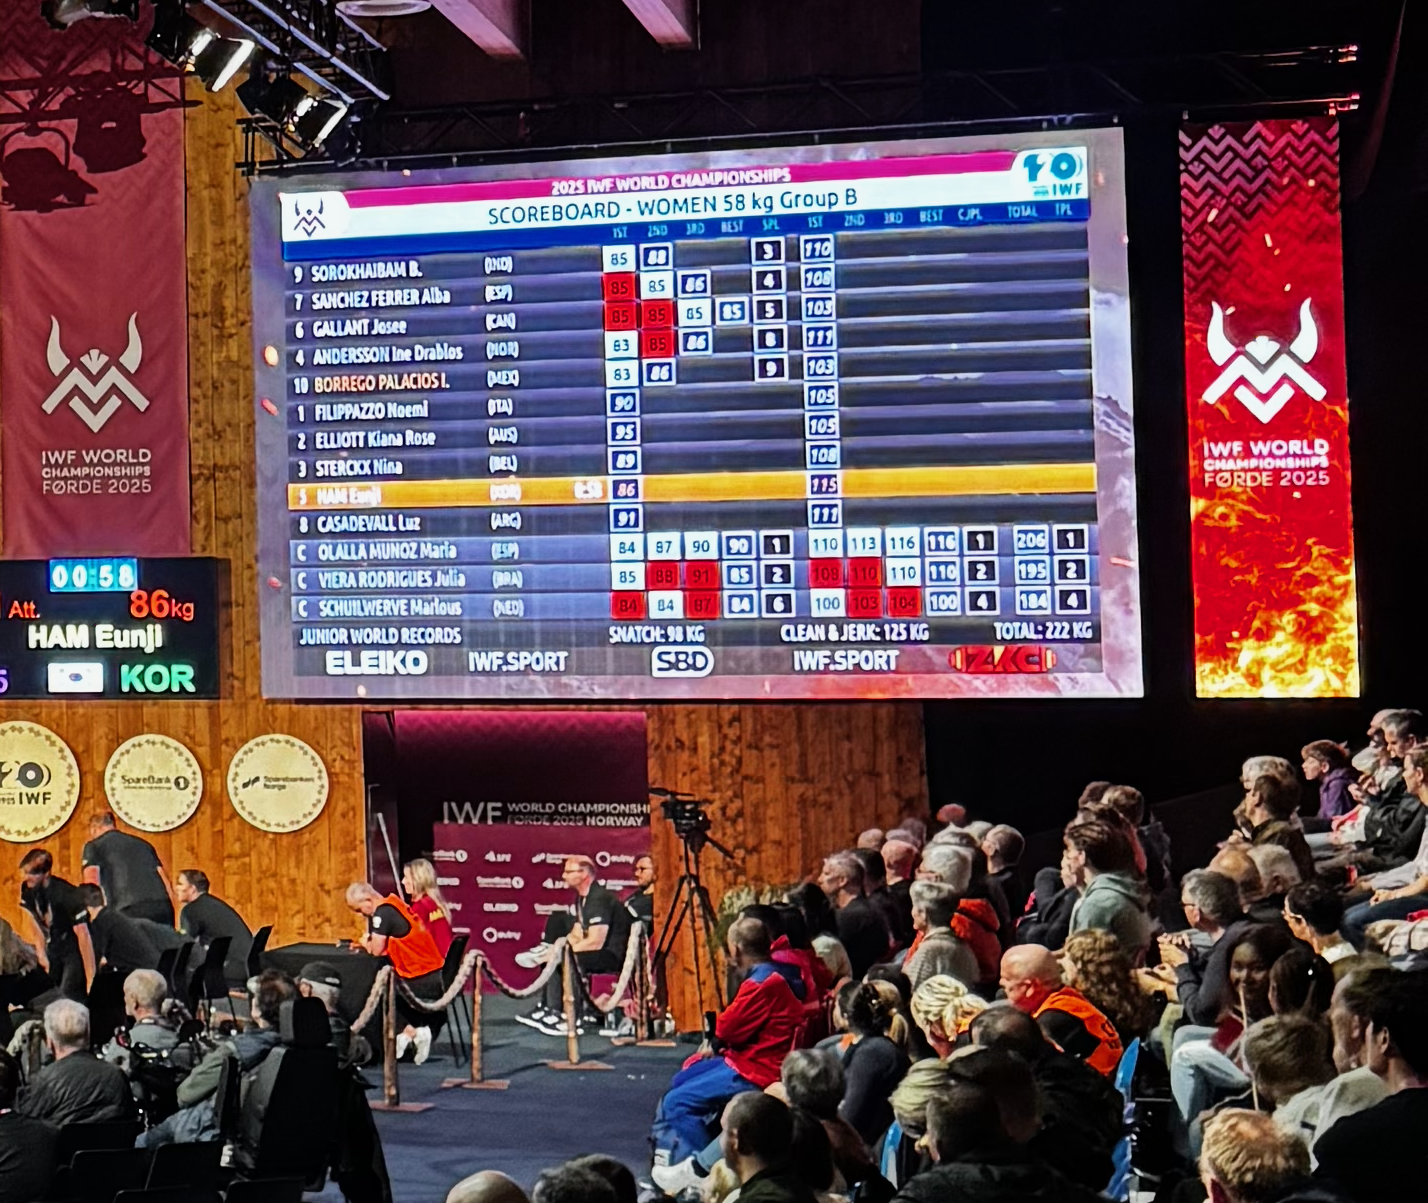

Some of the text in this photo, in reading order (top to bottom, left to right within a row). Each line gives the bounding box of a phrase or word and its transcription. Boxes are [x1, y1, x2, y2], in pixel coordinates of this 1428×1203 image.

[552, 168, 791, 195] 2025 IWF WORLD CHAMPIONSHIPS
[1052, 183, 1083, 196] IWF
[489, 188, 858, 225] SCOREBOARD WOMEN 58 kg Group B
[721, 209, 944, 233] BEST BEST
[294, 241, 832, 283] 9 SOROKHAIBAM 85 110
[311, 290, 370, 310] SANCHEZ
[371, 288, 419, 308] FERRER
[421, 286, 450, 304] Alba
[648, 279, 665, 292] 85
[313, 317, 407, 338] GALLANT Josee
[295, 349, 305, 366] 4
[313, 346, 391, 365] ANDERSSON
[414, 343, 463, 361] Drablos
[294, 372, 439, 394] 10 BORREGO PALACIOS
[315, 402, 385, 421] FILIPPAZZO
[387, 400, 429, 418] Noemi
[315, 431, 366, 450] ELLIOTT
[367, 430, 403, 448] Kiana
[405, 429, 436, 446] Rose
[1204, 438, 1329, 457] IWF WORLD
[42, 449, 151, 464] IWF WORLD
[315, 457, 403, 477] STERCKX Nina
[1203, 456, 1329, 471] CHAMPIONSHIPS
[42, 466, 151, 478] CHAMPIONSHIPS
[1204, 470, 1330, 488] FØRDE 2025
[42, 479, 151, 495] FØRDE 2025
[811, 477, 837, 492] 115
[317, 515, 397, 533] CASADEVALL
[398, 514, 421, 531] Luz
[617, 511, 636, 527] 91
[812, 507, 838, 522] 111
[318, 532, 1045, 561] OLALLA MUNOZ Maria 84 87 90 110 113 116 116 206
[51, 566, 135, 588] 00:58
[319, 563, 1047, 589] VIERA RODRIGUES Julia 85 110 110 195
[8, 601, 40, 619] Att.
[319, 598, 408, 617] SCHUILWERVE
[657, 599, 674, 611] 84
[815, 597, 840, 611] 100
[930, 593, 957, 609] 100
[28, 625, 163, 653] HAM Eunji
[300, 628, 348, 645] JUNIOR
[350, 628, 398, 644] WORLD
[401, 627, 462, 644] RECORDS
[687, 625, 705, 642] KG
[781, 624, 827, 641] CLEAN
[841, 624, 880, 641] JERK:
[883, 624, 909, 640] 125
[910, 624, 929, 641] KG
[994, 622, 1043, 639] TOTAL:
[1045, 622, 1070, 639] 222
[1073, 622, 1093, 639] KG
[325, 650, 899, 675] ELEIKO IWF.SPORT SBD IWF.SPORT
[120, 665, 196, 692] KOR
[19, 792, 51, 805] IWF
[507, 803, 651, 814] WORLD CHAMPIONSHI
[443, 801, 502, 825] IWF
[586, 816, 644, 826] NORWAY
